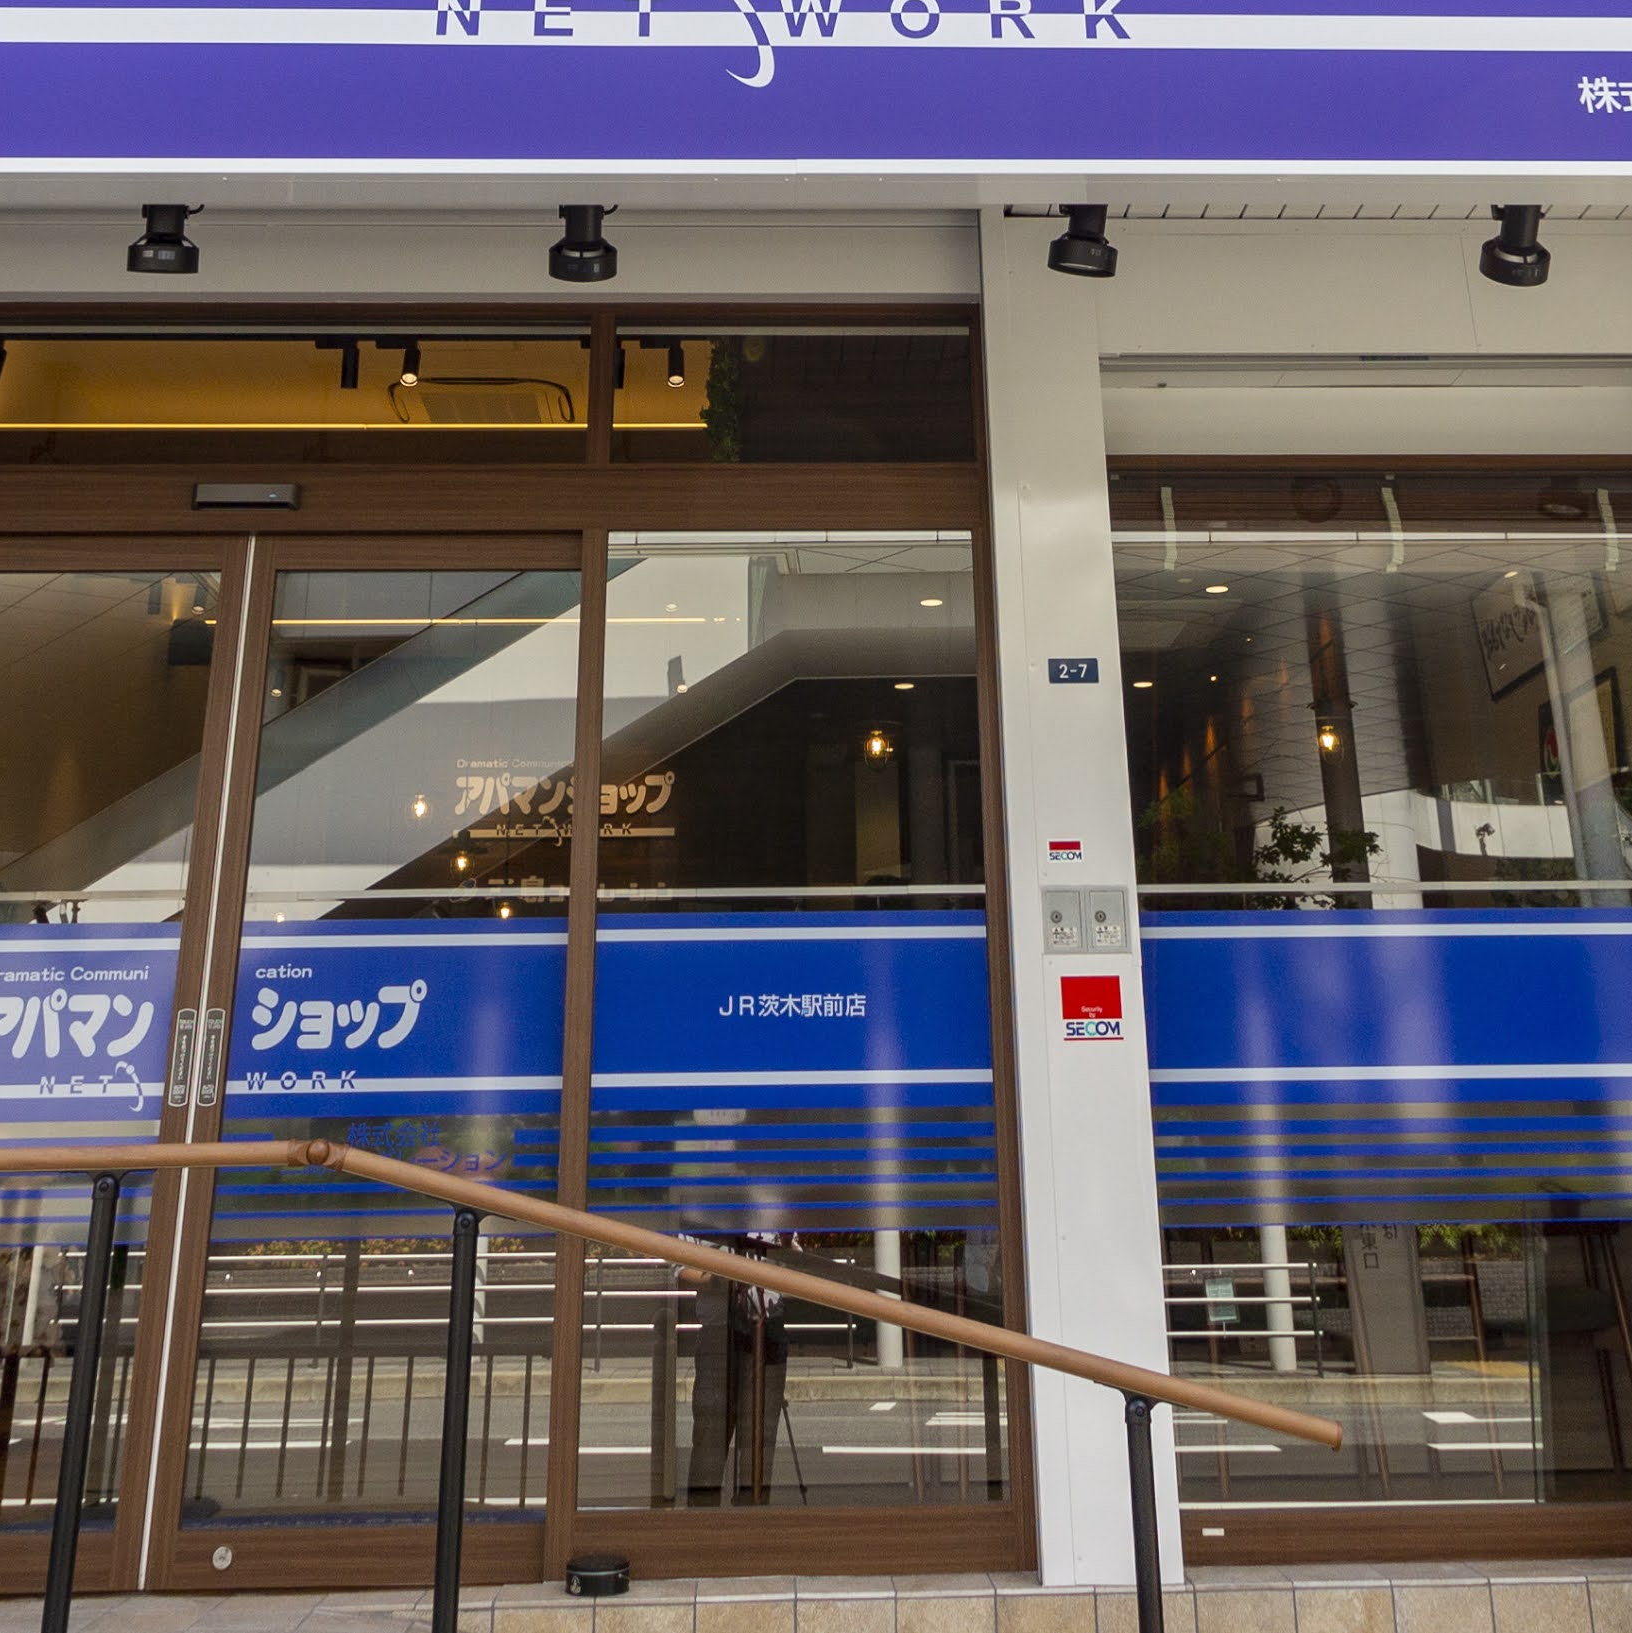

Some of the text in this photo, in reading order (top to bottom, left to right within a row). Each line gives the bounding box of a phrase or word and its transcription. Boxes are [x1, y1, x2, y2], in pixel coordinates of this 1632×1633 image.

[1059, 663, 1088, 679] 2-7
[453, 771, 676, 816] アパマンョップ
[1049, 851, 1083, 861] SECOM
[1065, 1020, 1121, 1036] SECOM
